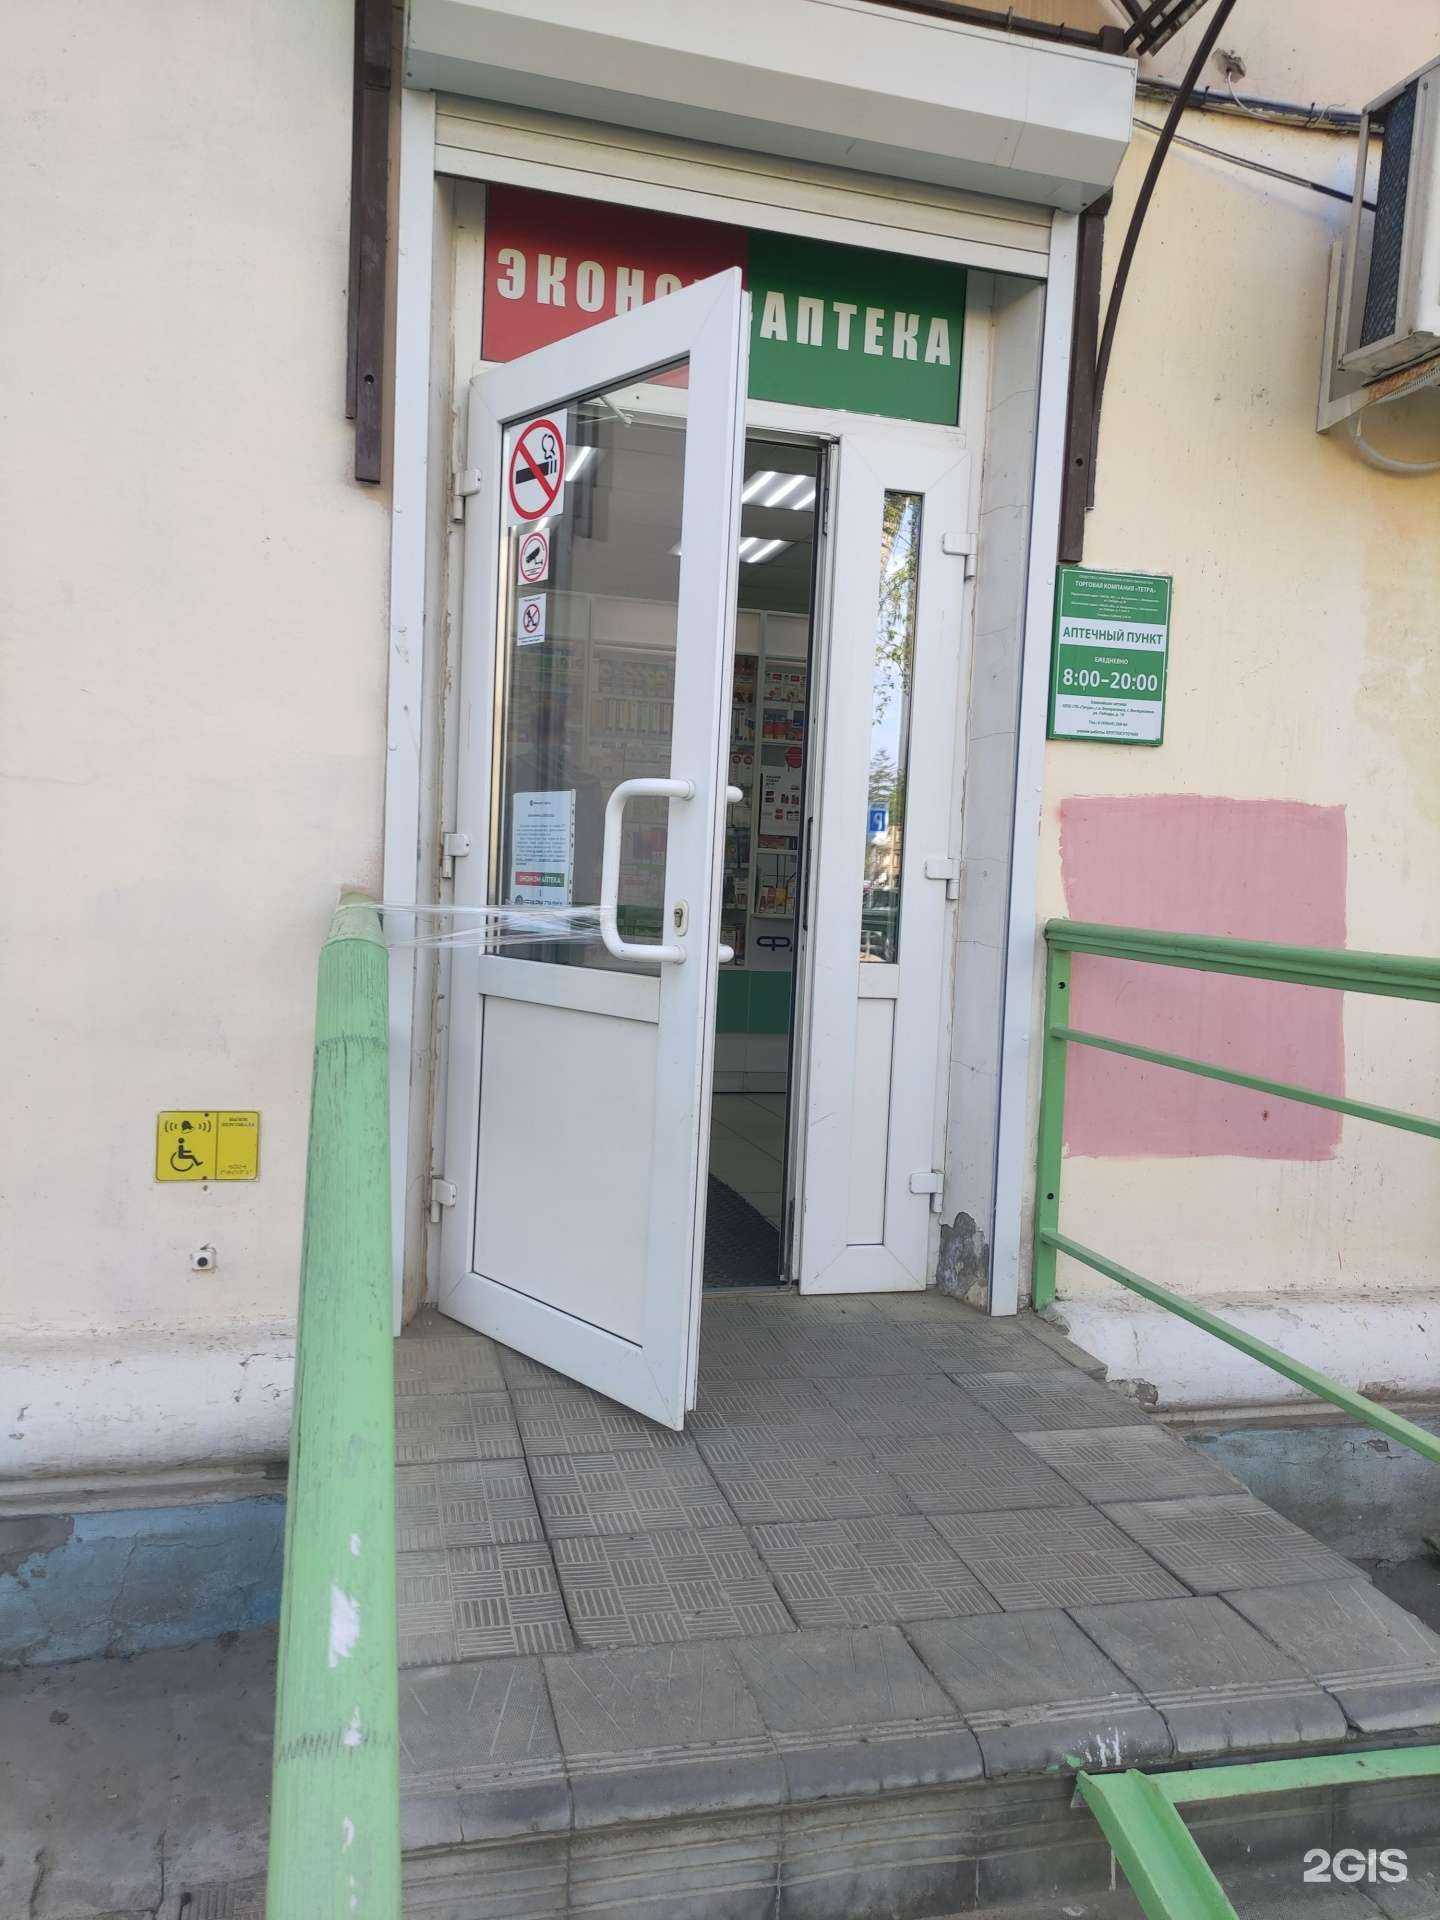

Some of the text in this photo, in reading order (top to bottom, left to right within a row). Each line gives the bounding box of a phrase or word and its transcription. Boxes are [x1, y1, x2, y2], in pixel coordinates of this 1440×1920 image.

[495, 246, 951, 366] ЭКОН АПТЕКА
[1063, 626, 1163, 645] АПТЕЧНЫЙ ПУНКТ
